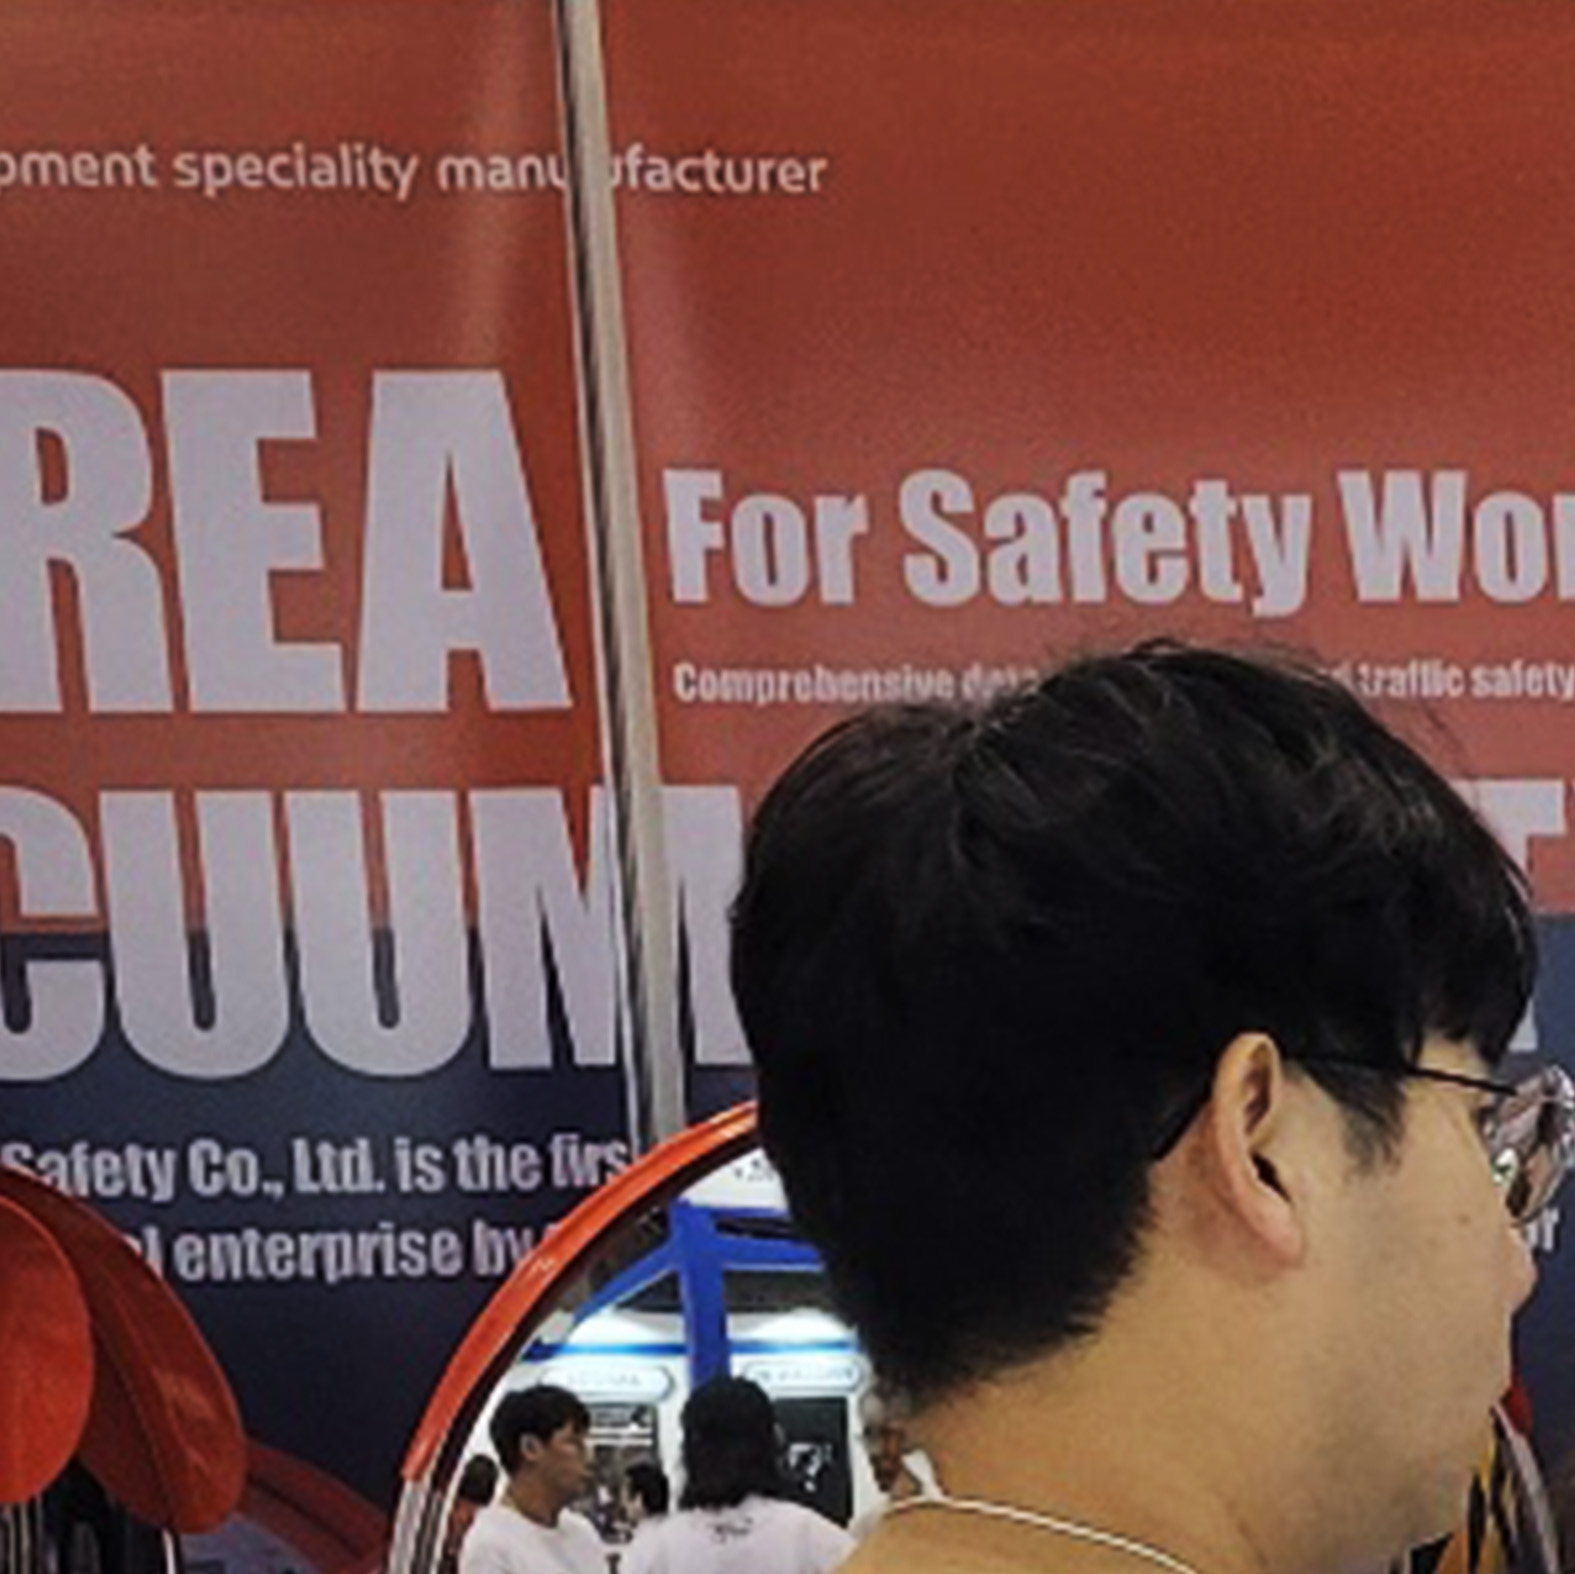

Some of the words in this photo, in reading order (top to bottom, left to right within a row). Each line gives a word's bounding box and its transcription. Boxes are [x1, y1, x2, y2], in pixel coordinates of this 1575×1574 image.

[173, 143, 420, 202] speciality
[662, 469, 868, 606] For
[900, 469, 1312, 618] Safety
[673, 661, 954, 707] Comprehensive
[1359, 659, 1464, 698] traffic
[187, 1139, 284, 1201] Co.,
[294, 1137, 384, 1195] Ltd.
[397, 1133, 441, 1189] is
[453, 1134, 542, 1188] the
[550, 1131, 630, 1187] firs
[173, 1222, 462, 1284] enterprise
